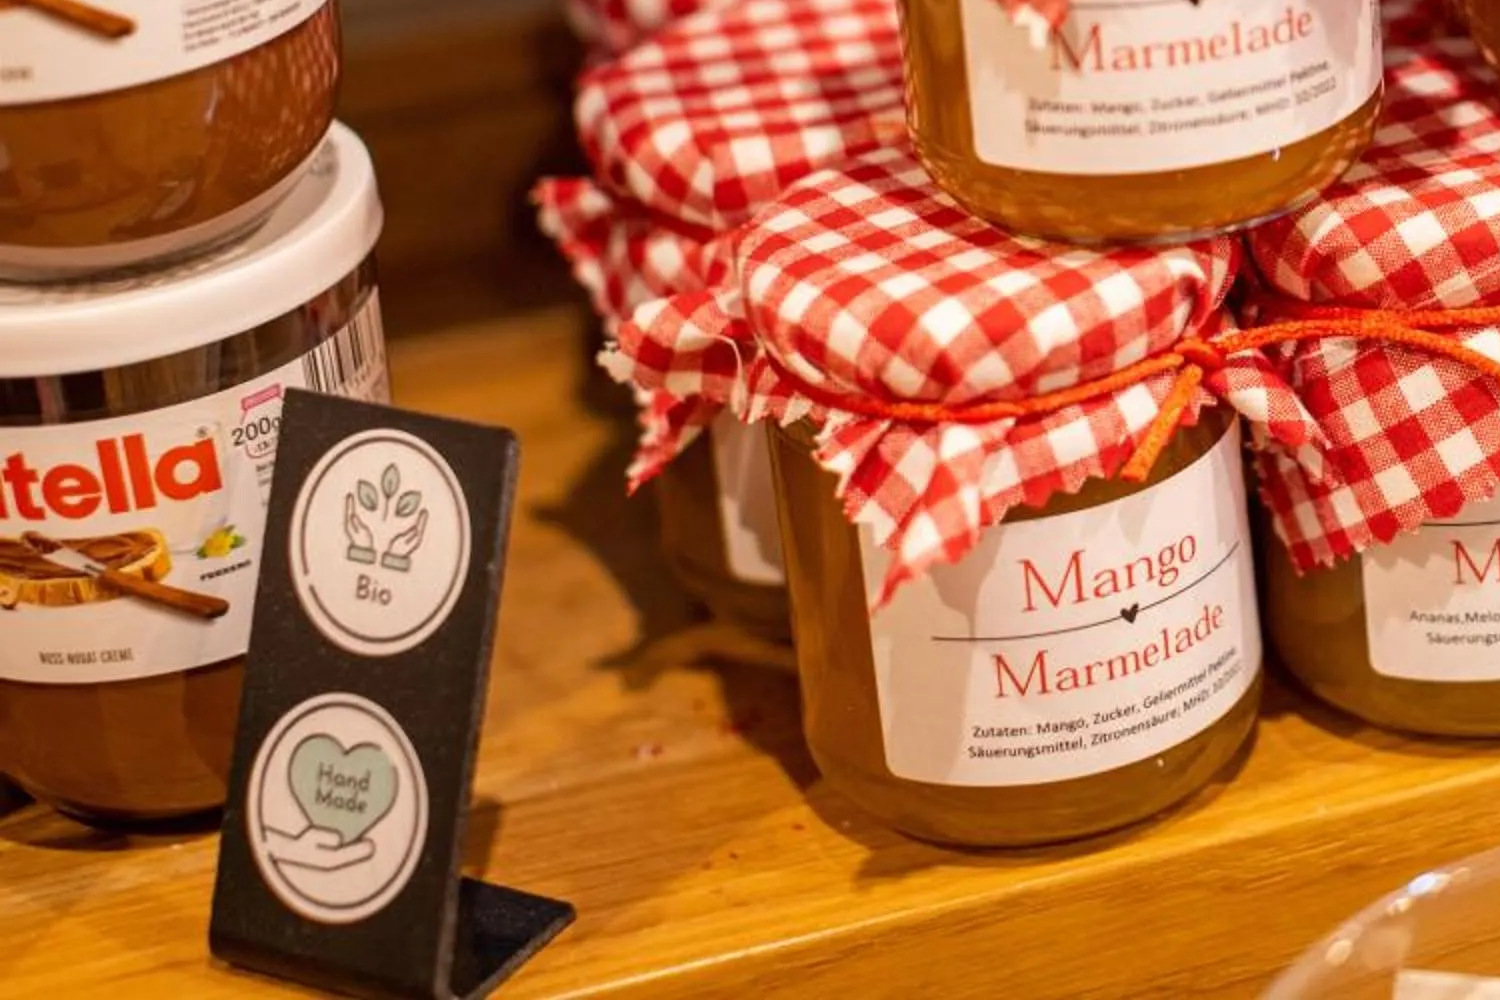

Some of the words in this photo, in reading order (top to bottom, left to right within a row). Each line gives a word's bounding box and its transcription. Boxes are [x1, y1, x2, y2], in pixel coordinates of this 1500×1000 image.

[1050, 5, 1313, 76] Marmelade
[355, 573, 392, 606] Bio
[1015, 534, 1197, 613] Mango
[990, 603, 1224, 698] Marmelade
[972, 724, 1033, 738] Zutaten:
[1036, 717, 1089, 734] Mango,
[317, 762, 371, 792] Hand
[315, 789, 368, 814] Made
